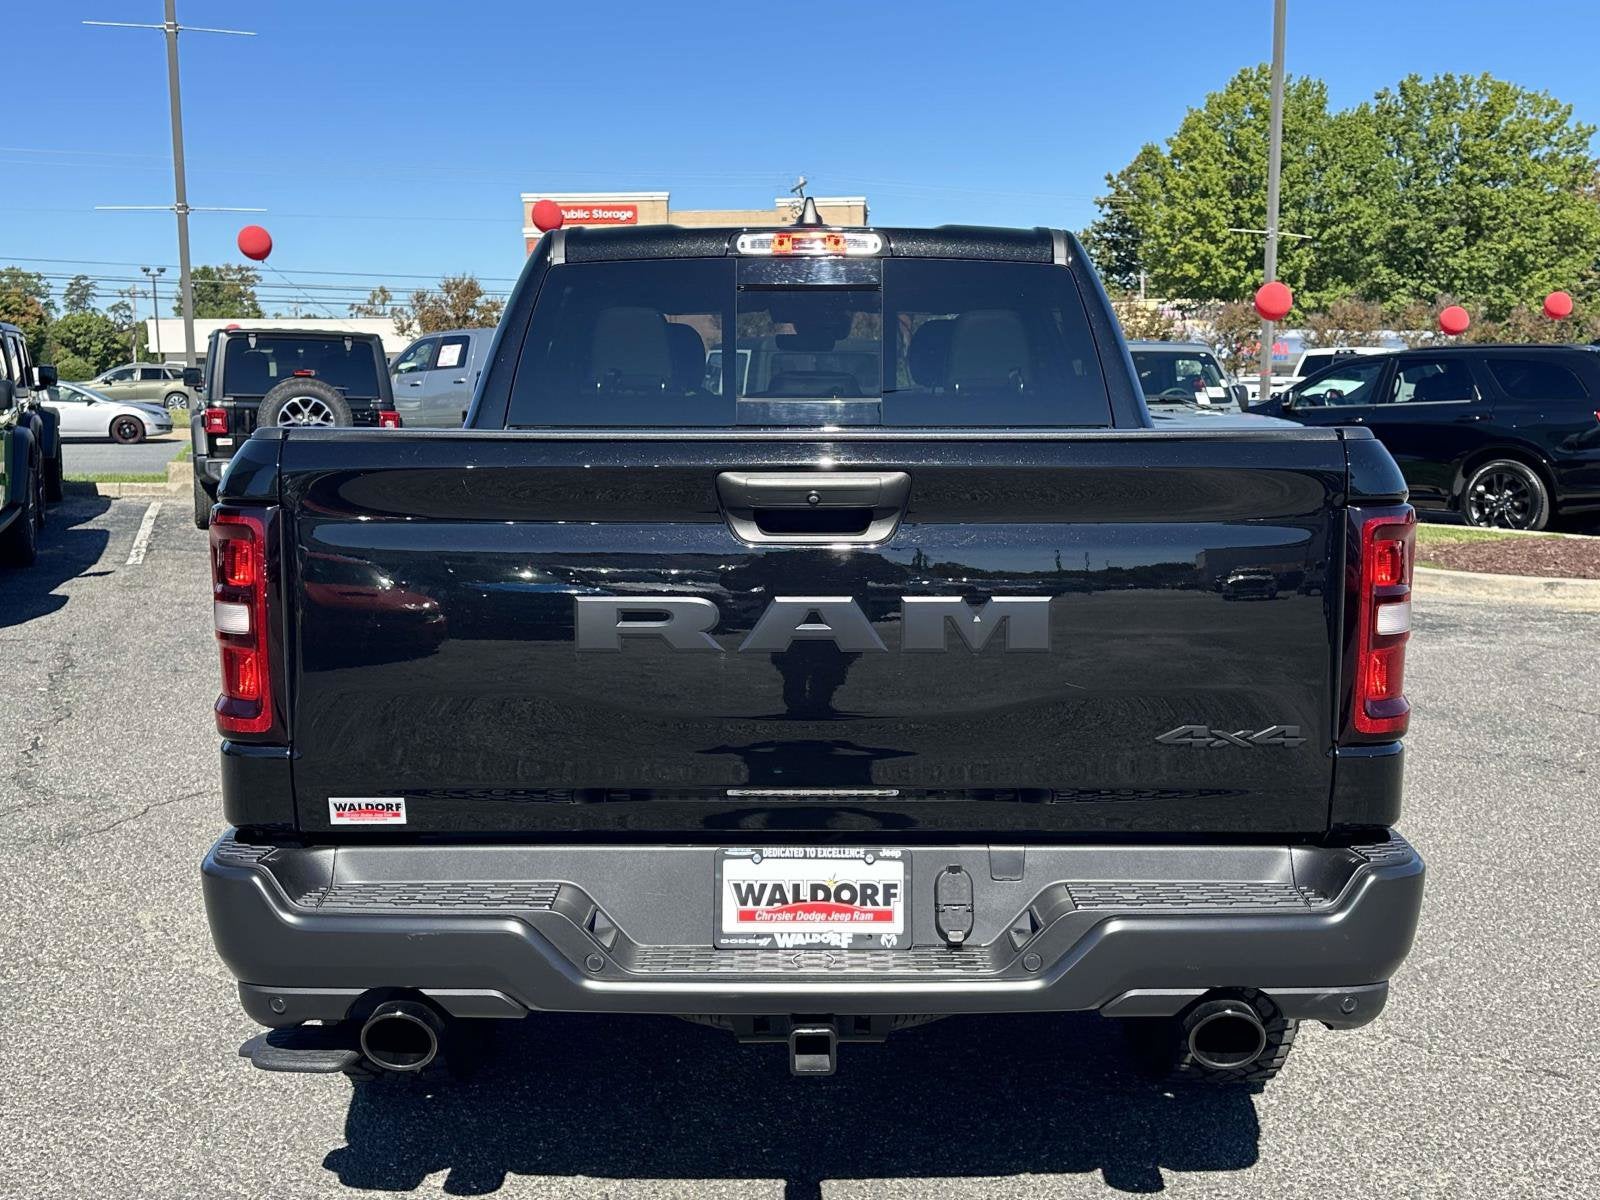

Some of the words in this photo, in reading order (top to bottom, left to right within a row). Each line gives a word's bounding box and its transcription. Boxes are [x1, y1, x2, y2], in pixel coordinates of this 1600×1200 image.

[592, 209, 634, 222] Storage
[575, 596, 1053, 653] RAM
[1155, 725, 1307, 747] 4x4
[334, 803, 401, 812] WALDORF
[763, 848, 804, 858] DEDICATED
[805, 848, 816, 858] TO
[817, 848, 865, 858] EXCELLENCE
[879, 849, 901, 858] Jeep
[733, 883, 898, 907] WALDORF
[755, 910, 795, 922] Chrysler
[796, 910, 827, 922] Dodge
[828, 910, 850, 922] Jeep
[852, 911, 873, 921] Ram
[774, 933, 853, 948] WALDORF
